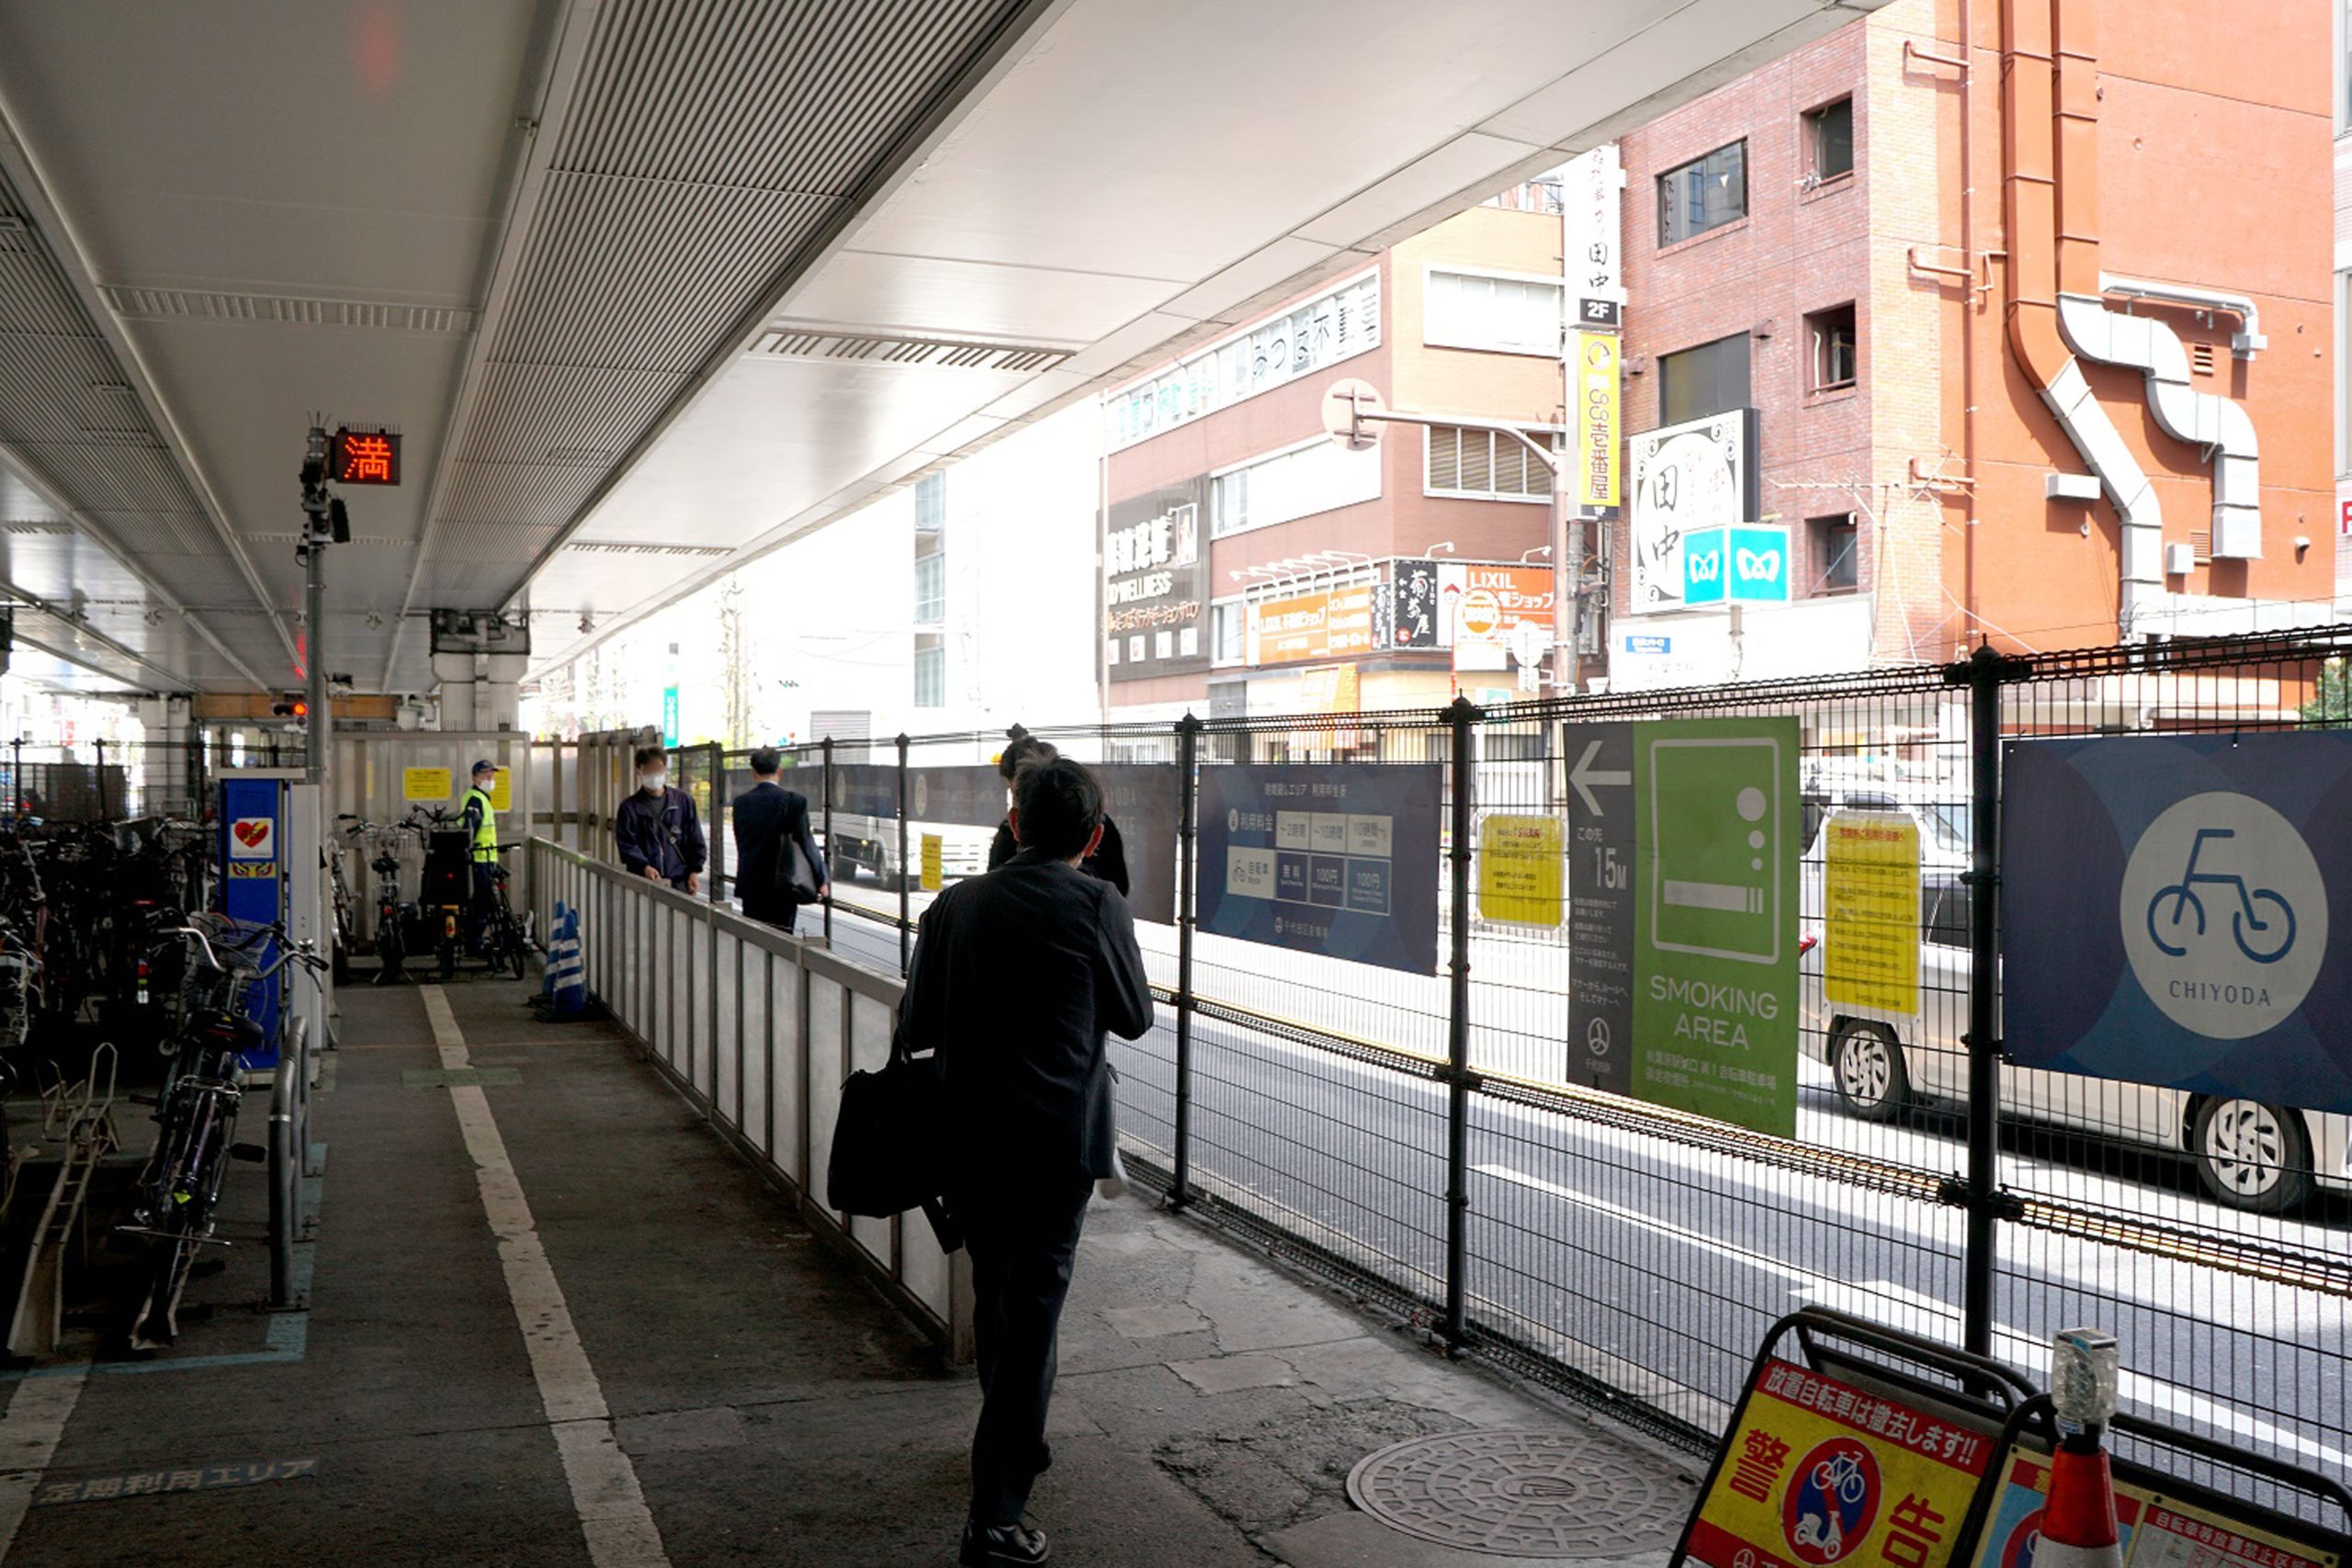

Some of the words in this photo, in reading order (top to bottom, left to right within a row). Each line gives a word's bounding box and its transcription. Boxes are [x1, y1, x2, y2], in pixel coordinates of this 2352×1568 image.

[1587, 301, 1610, 319] 2F
[344, 435, 390, 479] 満
[1653, 464, 1679, 573] 田中
[1470, 571, 1517, 590] LIXIL
[1577, 827, 1603, 842] この先
[1650, 974, 1779, 1021] SMOKING
[2169, 980, 2271, 1007] CHIYODA
[1673, 1012, 1750, 1052] AREA
[1729, 1428, 1791, 1504] 警
[1882, 1493, 1945, 1568] 告
